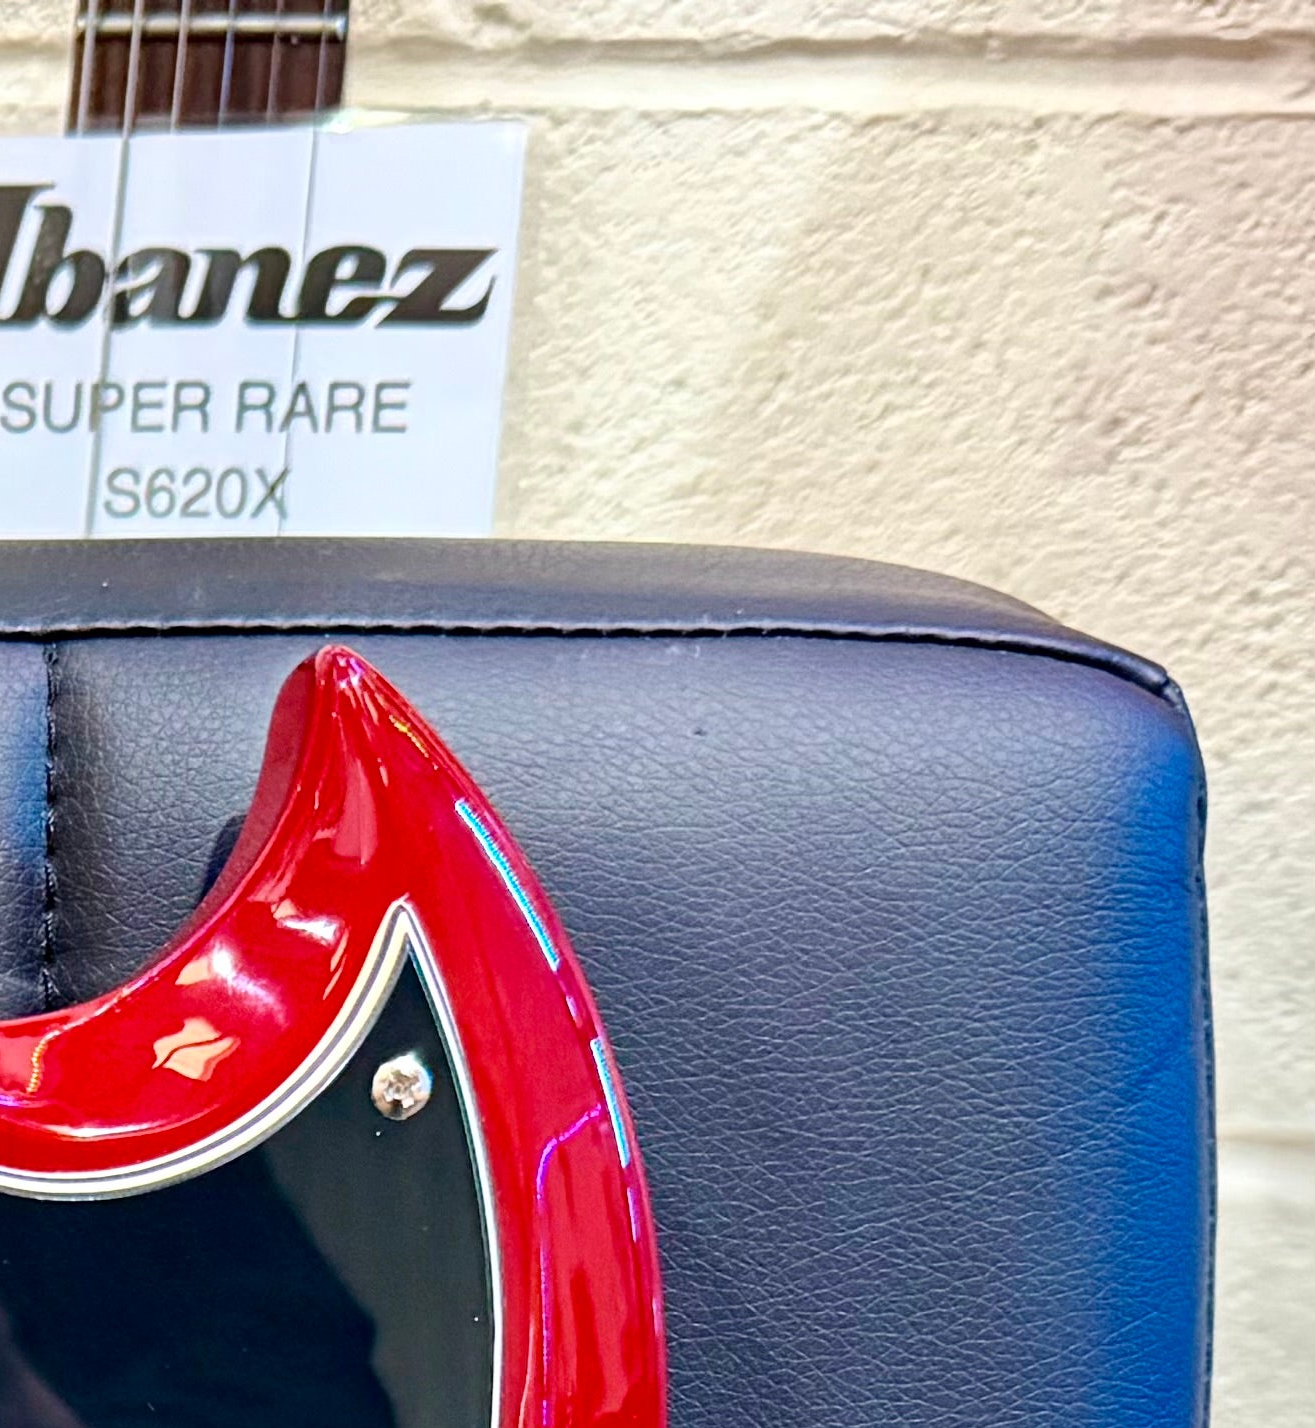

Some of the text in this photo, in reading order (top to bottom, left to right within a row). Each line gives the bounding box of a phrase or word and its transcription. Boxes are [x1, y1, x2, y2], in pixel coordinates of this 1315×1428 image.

[0, 379, 413, 435] SUPER RARE
[103, 465, 291, 520] S620X
